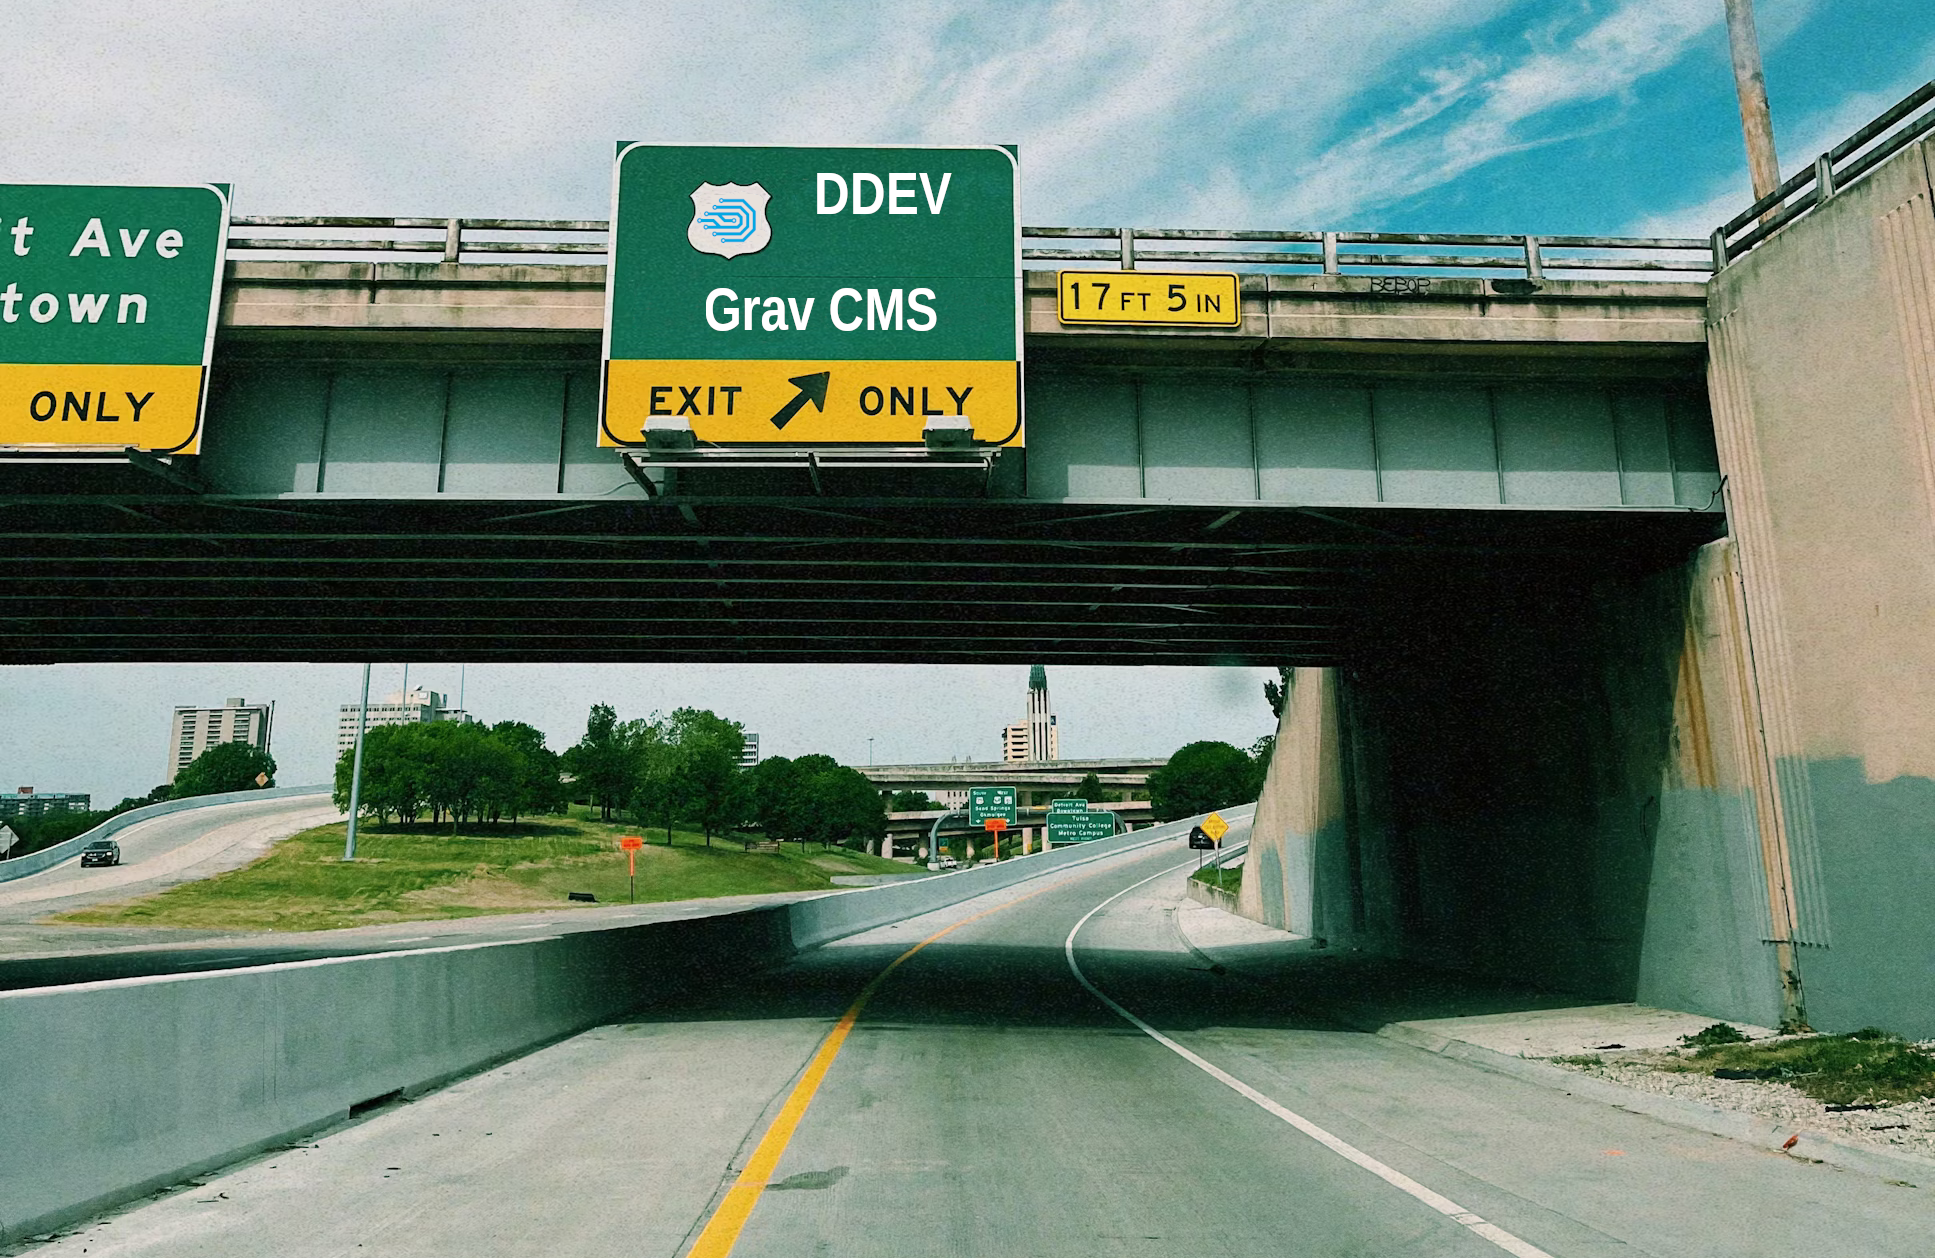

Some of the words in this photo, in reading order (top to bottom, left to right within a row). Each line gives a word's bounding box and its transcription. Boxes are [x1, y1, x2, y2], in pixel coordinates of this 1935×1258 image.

[816, 172, 952, 215] DDEV
[69, 217, 184, 259] Ave
[0, 282, 148, 324] town
[1071, 282, 1110, 310] 17
[1121, 292, 1151, 311] FT
[1167, 284, 1187, 312] 5
[1197, 294, 1220, 313] IN
[1370, 276, 1431, 295] BEBOP
[705, 287, 815, 332] Grav
[830, 287, 938, 332] CMS
[30, 390, 155, 422] ONLY
[649, 386, 742, 416] EXIT
[859, 385, 973, 416] ONLY
